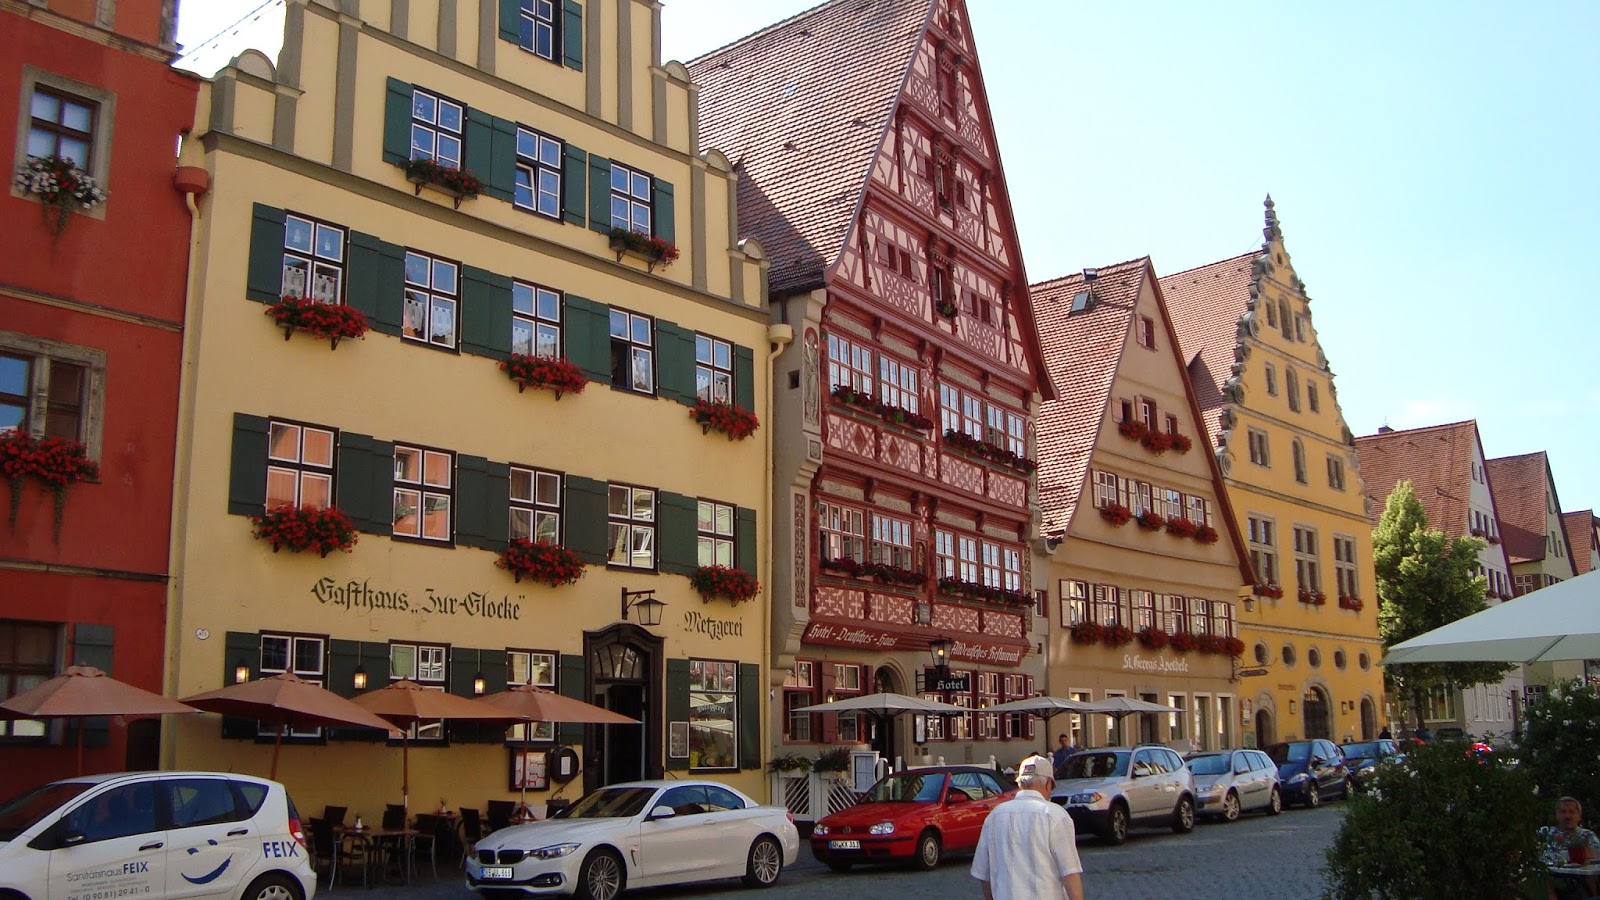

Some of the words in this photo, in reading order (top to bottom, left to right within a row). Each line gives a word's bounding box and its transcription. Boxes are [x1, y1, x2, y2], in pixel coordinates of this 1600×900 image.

[311, 577, 409, 613] Gasthaus
[684, 611, 743, 641] Metzgerei
[808, 623, 833, 639] Hotel
[936, 680, 964, 691] Hotel
[262, 841, 299, 858] FEIX
[123, 861, 149, 875] FEIX
